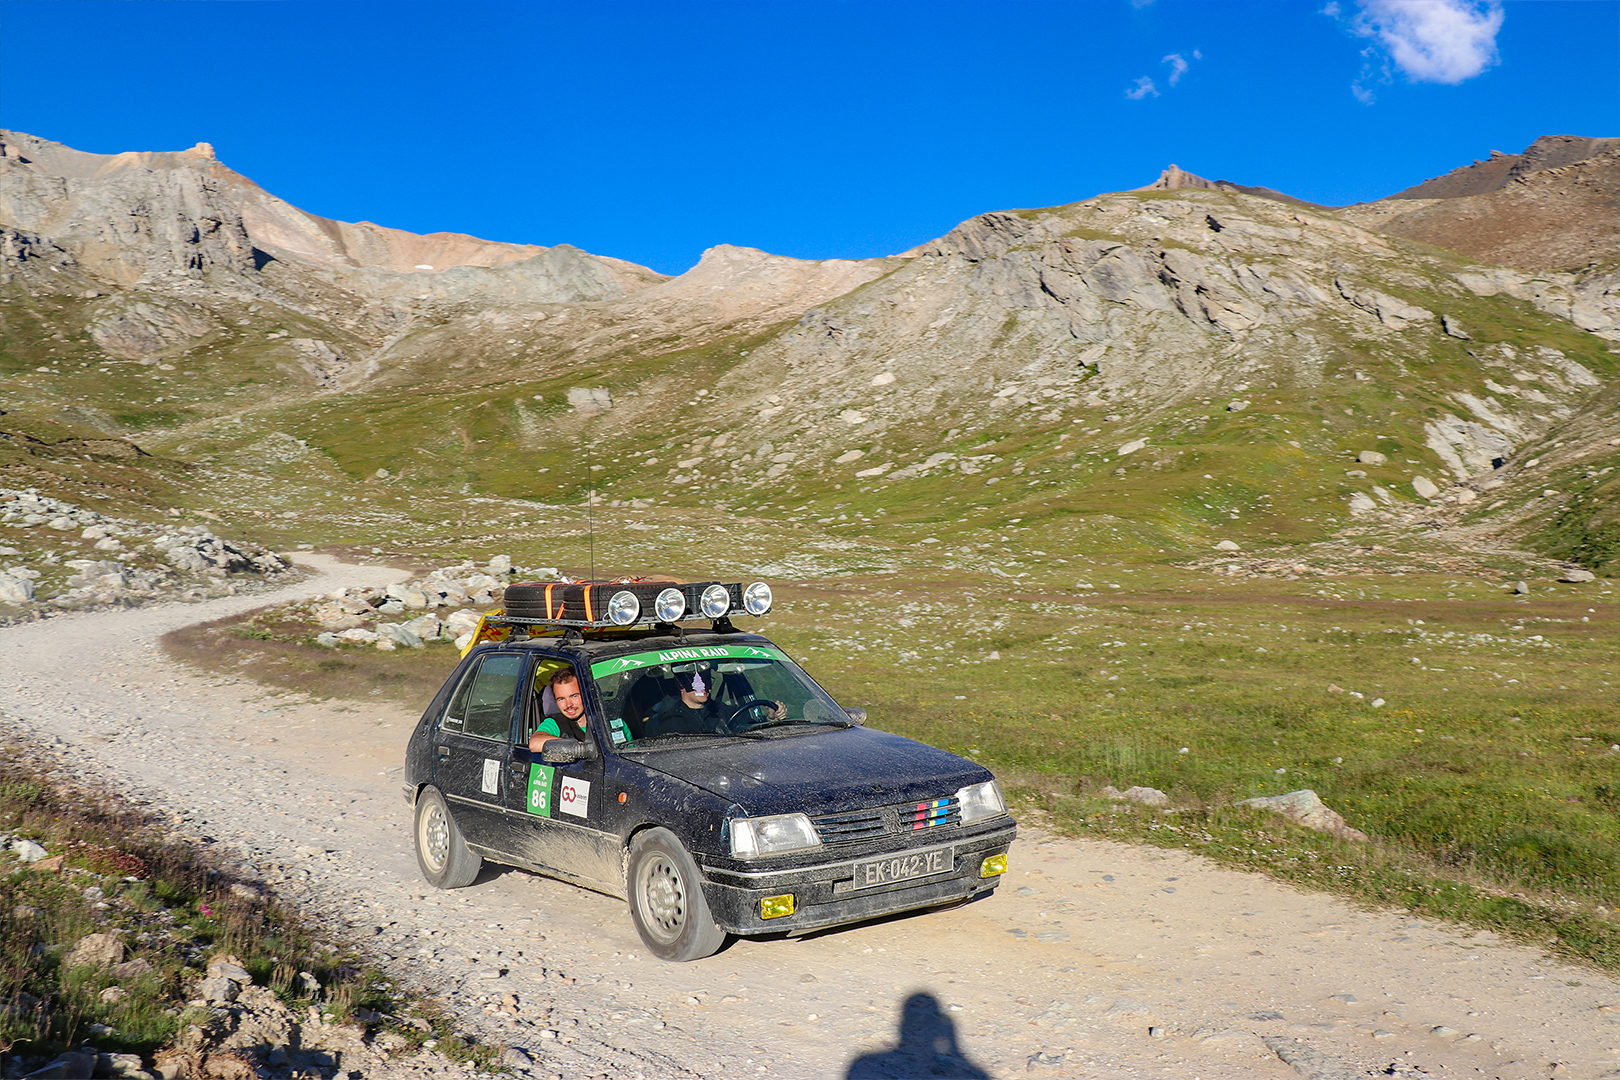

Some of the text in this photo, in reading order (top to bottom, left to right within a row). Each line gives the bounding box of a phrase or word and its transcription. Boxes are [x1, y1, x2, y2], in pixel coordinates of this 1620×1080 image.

[659, 647, 729, 662] ALPINA RAID
[532, 789, 546, 809] 86
[562, 785, 576, 803] GO
[866, 851, 943, 884] EK-042-YE
